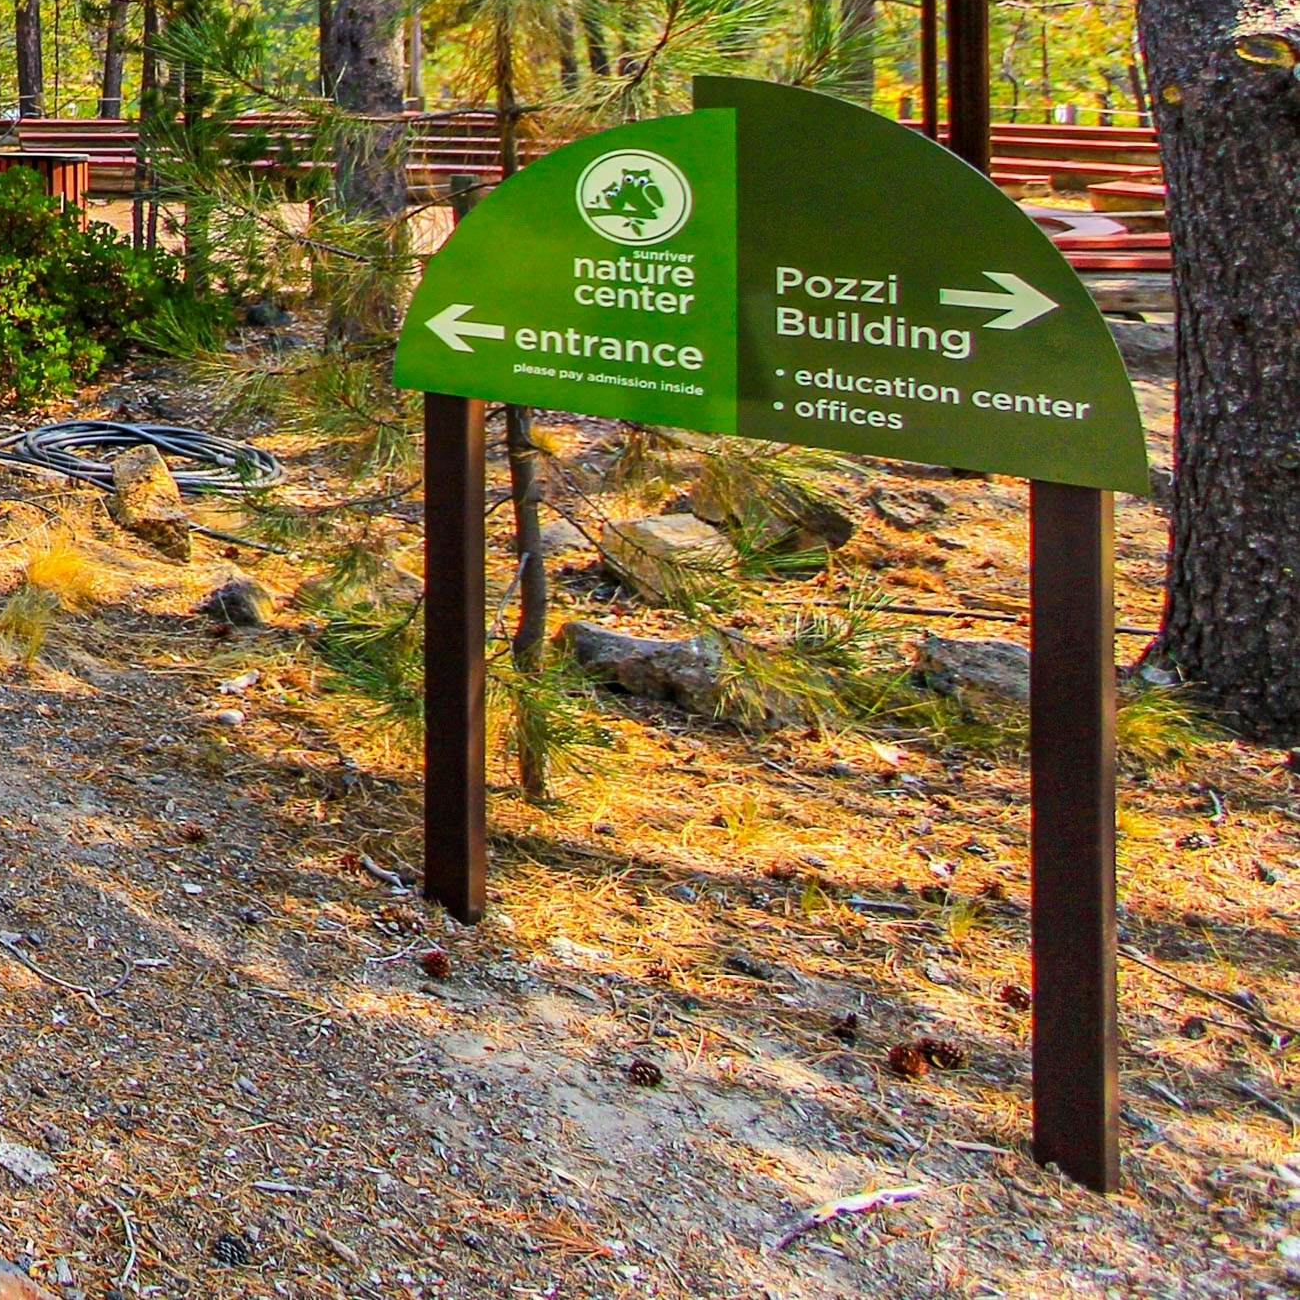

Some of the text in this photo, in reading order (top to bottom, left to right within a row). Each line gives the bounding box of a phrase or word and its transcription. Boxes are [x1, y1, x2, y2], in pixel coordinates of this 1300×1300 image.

[573, 256, 695, 288] nature
[632, 250, 695, 263] sunriver
[573, 285, 695, 315] center
[775, 266, 898, 305] Pozzi
[514, 327, 704, 370] entrance
[775, 306, 972, 360] Building
[513, 363, 704, 396] please pay admission inside
[794, 368, 1091, 420] education center
[794, 398, 904, 430] offices
